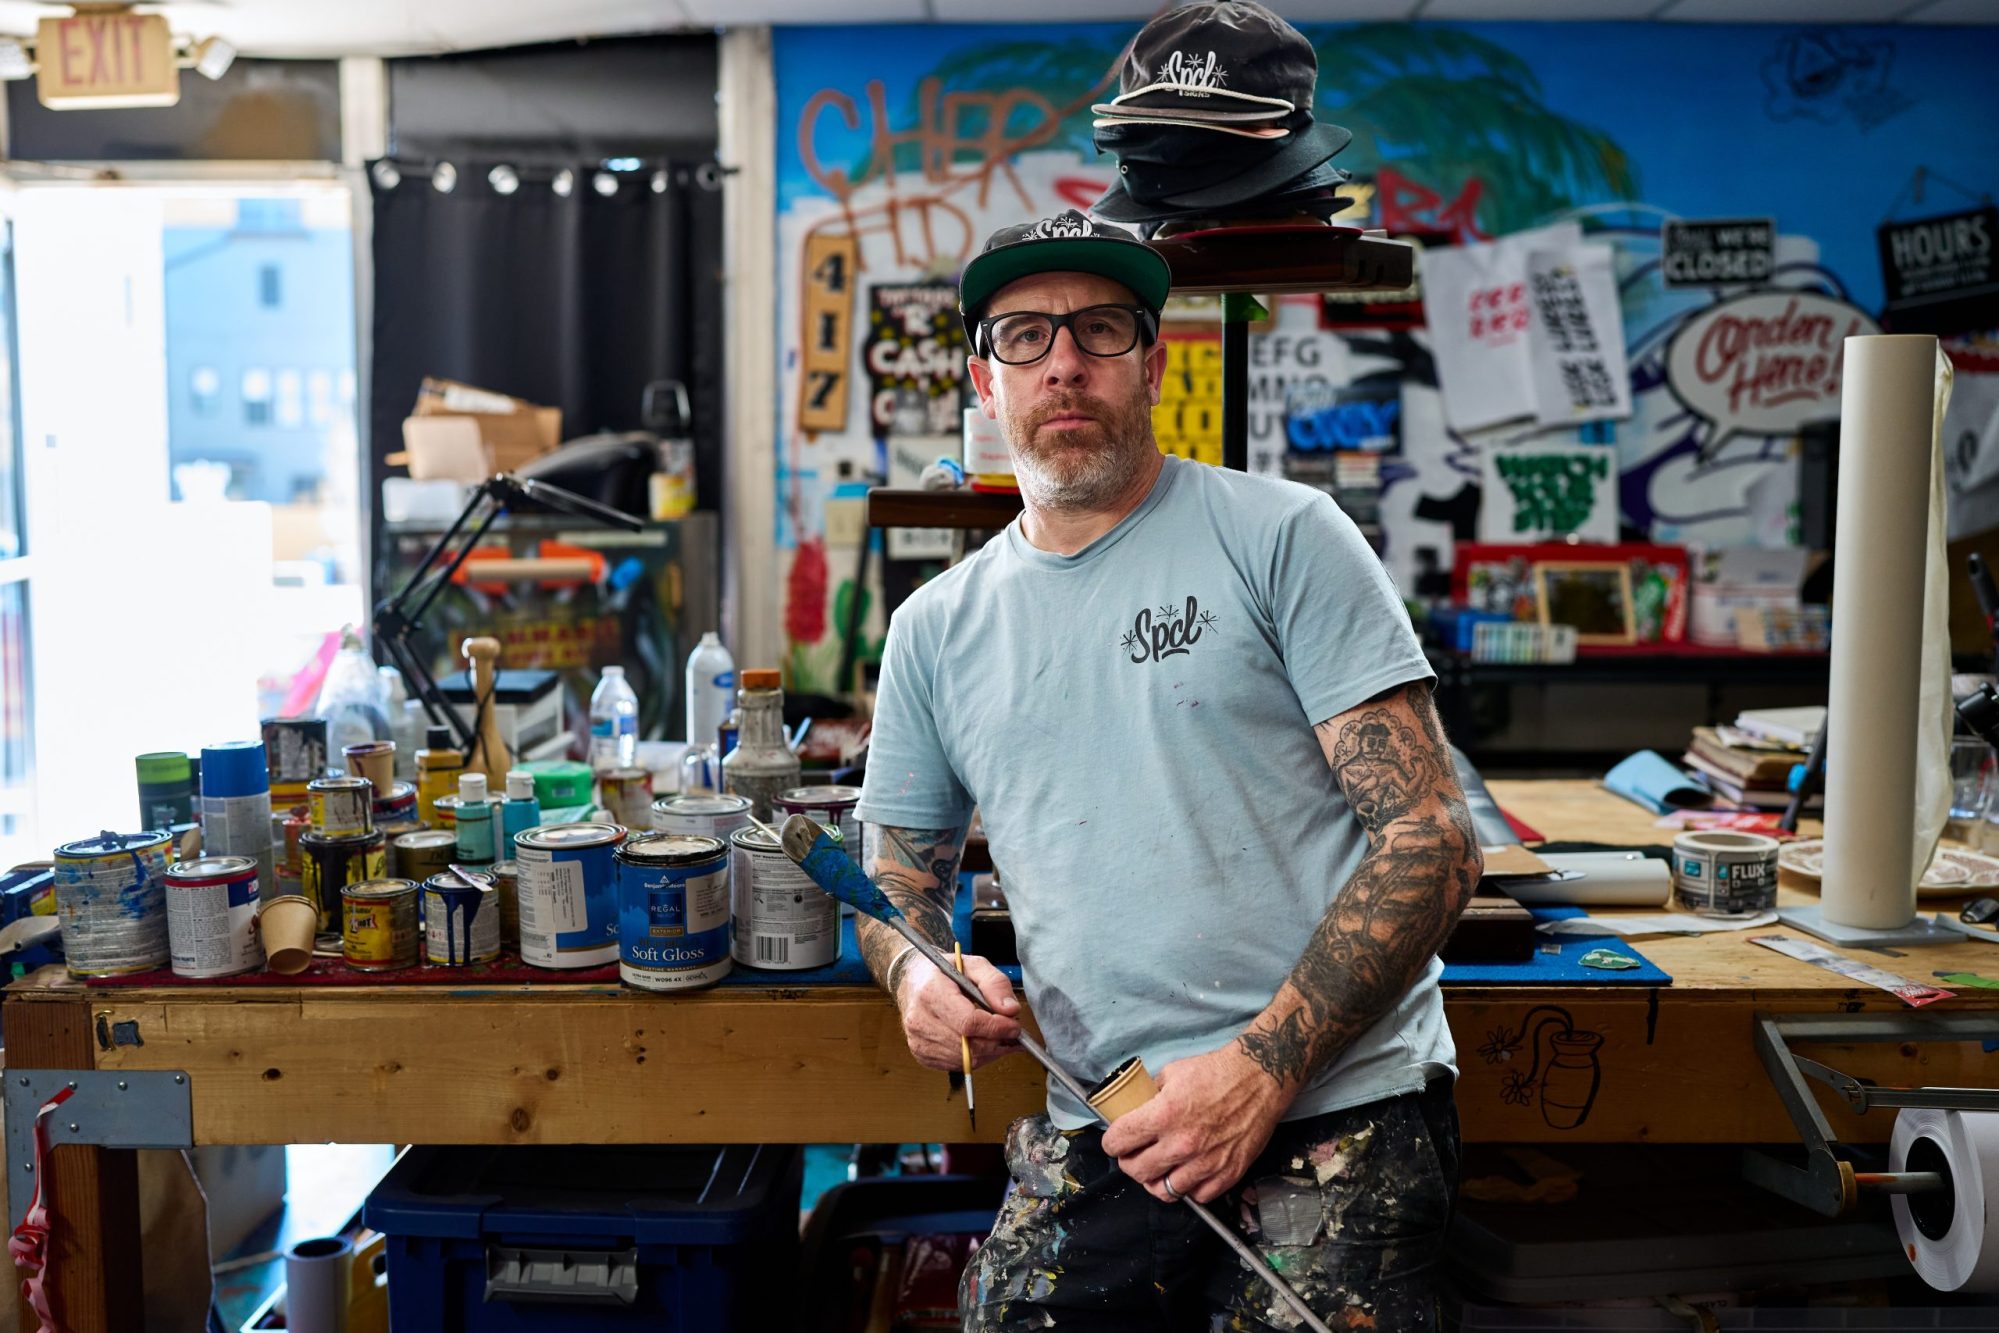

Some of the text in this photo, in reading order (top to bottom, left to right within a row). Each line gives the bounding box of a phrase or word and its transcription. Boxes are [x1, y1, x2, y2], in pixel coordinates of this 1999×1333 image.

[59, 17, 148, 87] EXIT
[1890, 214, 1992, 271] HOURS
[1665, 251, 1772, 282] CLOSED
[868, 339, 965, 380] CASH
[1131, 595, 1203, 664] Spcl
[1731, 863, 1766, 880] FLUX
[650, 904, 681, 913] REGAL
[632, 945, 705, 961] Soft Gloss
